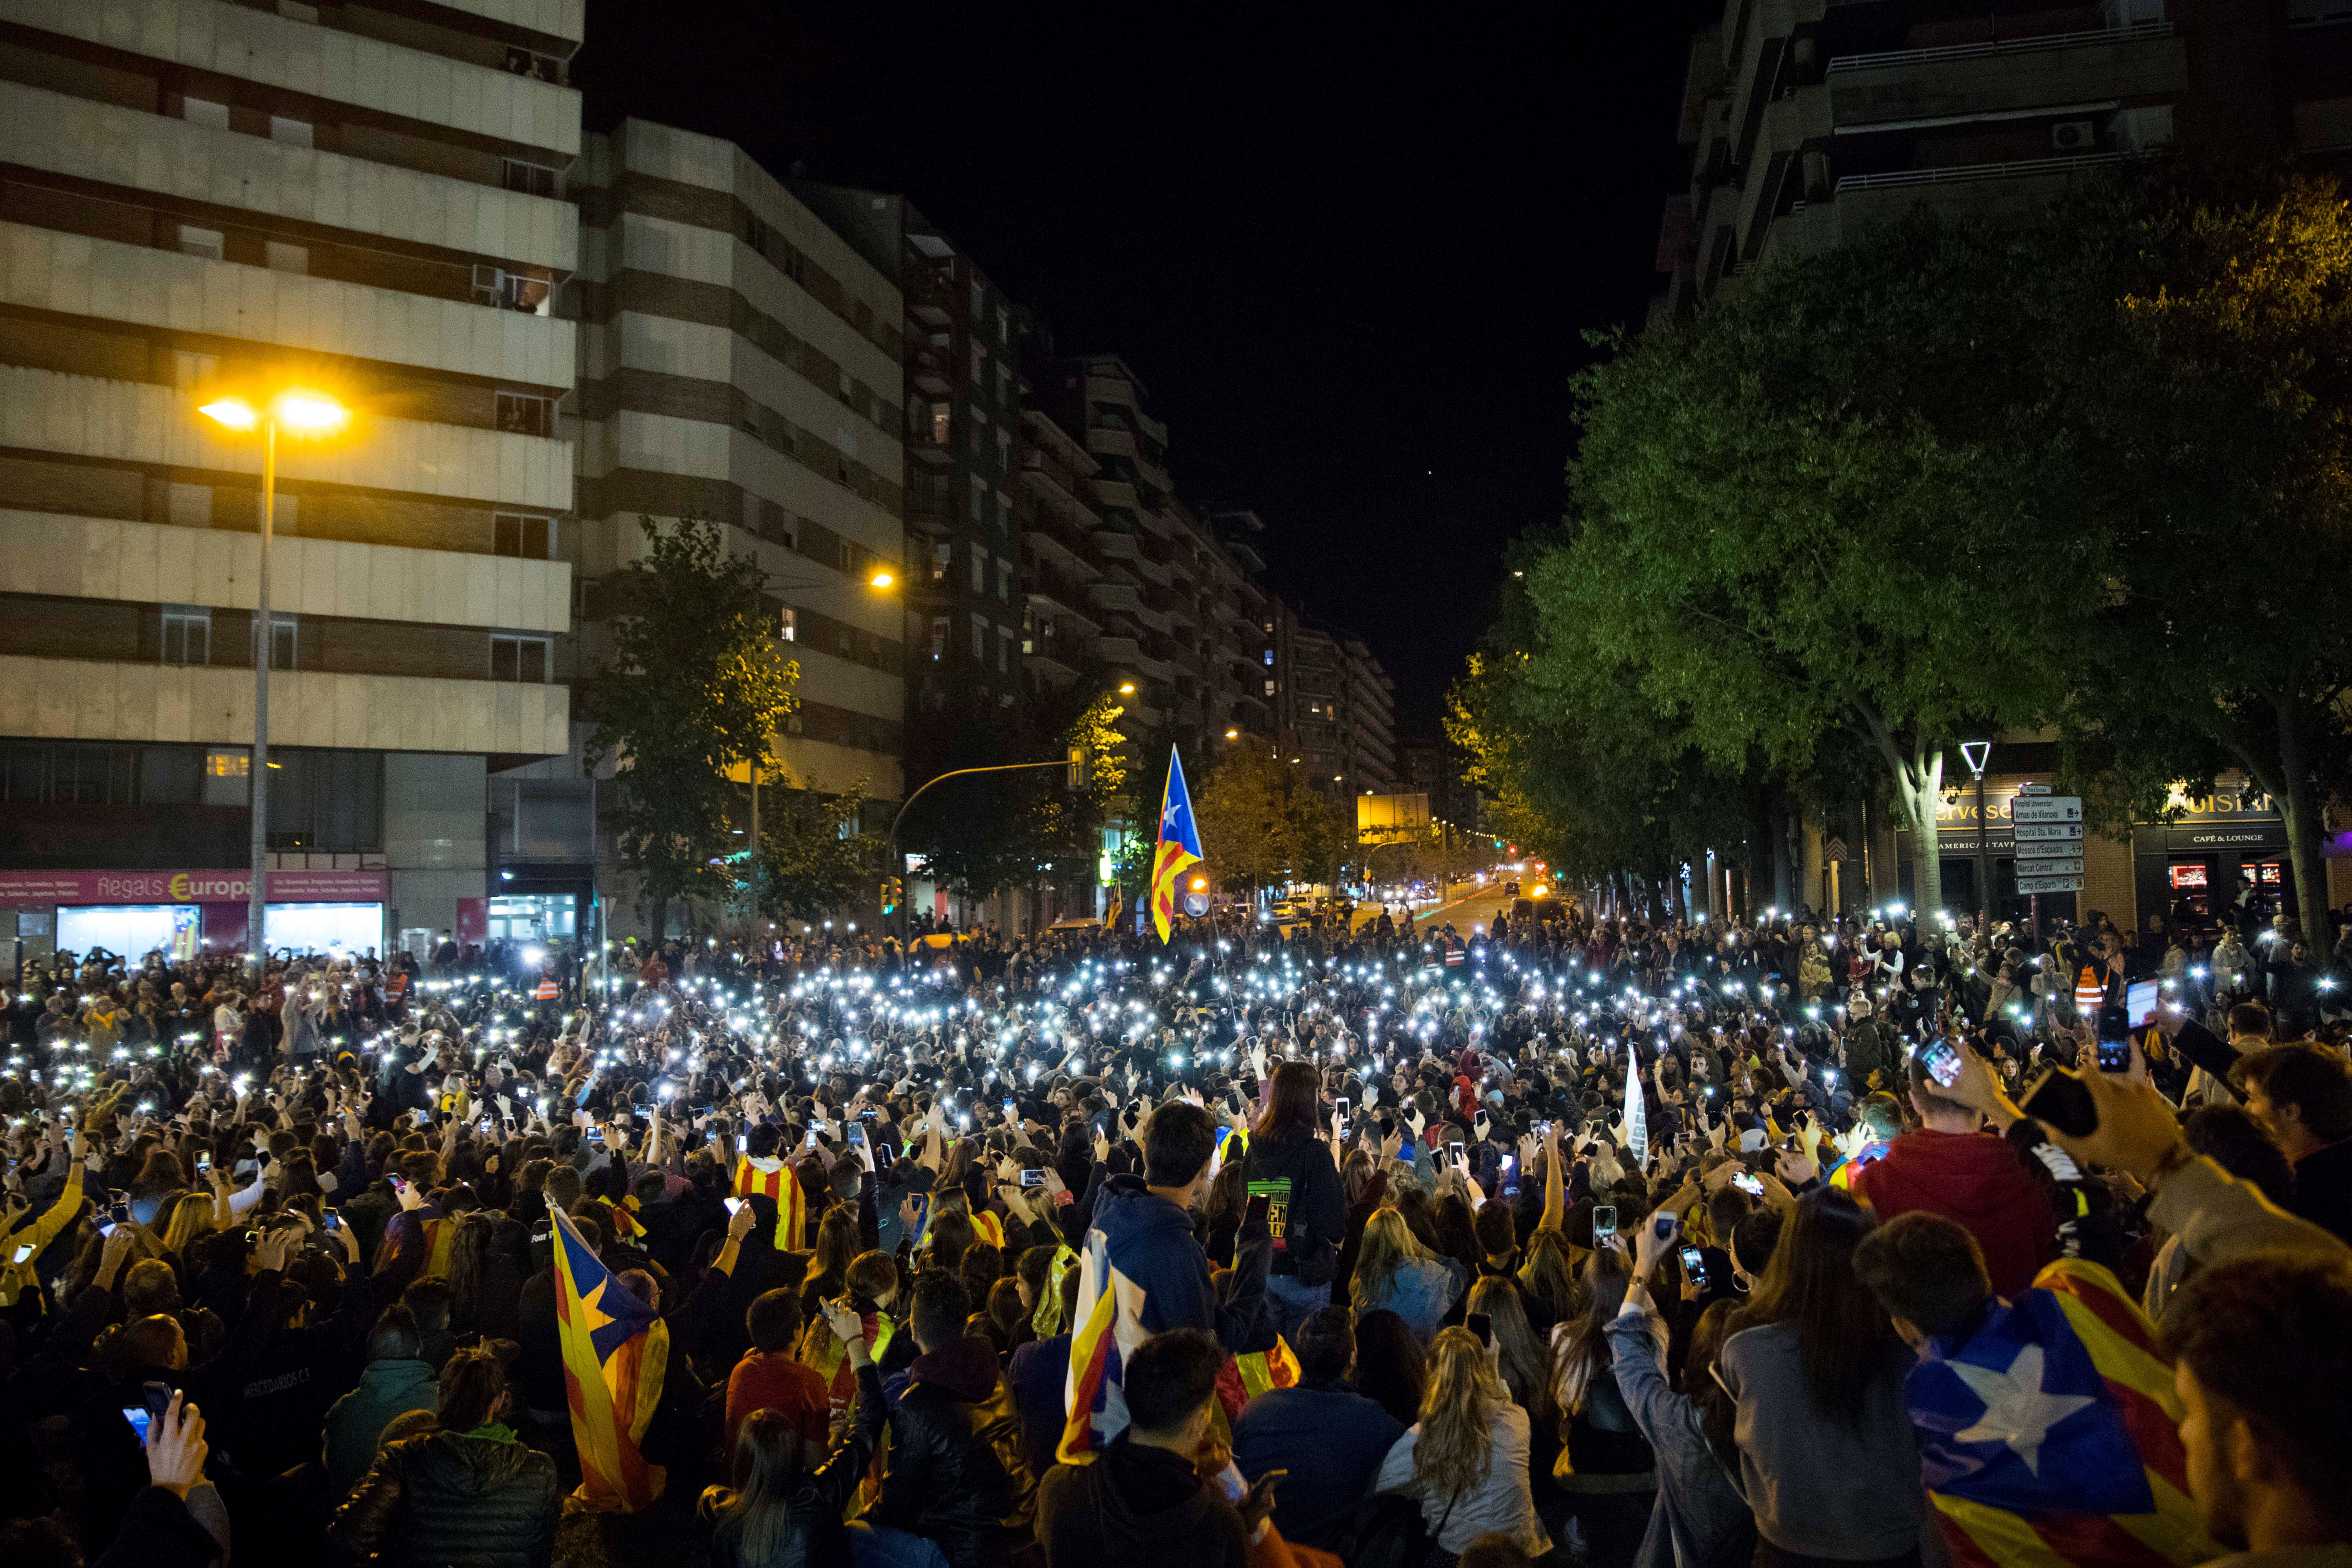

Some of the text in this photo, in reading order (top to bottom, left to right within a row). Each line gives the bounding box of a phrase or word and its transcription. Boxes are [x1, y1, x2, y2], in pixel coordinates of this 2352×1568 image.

[2038, 810, 2058, 819] Vilanova
[2016, 827, 2036, 838] Hospital
[2048, 827, 2061, 836] Maria
[2017, 845, 2063, 855] Mossos d'Esquadra
[2036, 863, 2053, 872] Central
[98, 877, 163, 899] Regals
[2019, 881, 2034, 891] Camp
[531, 1233, 547, 1243] Four
